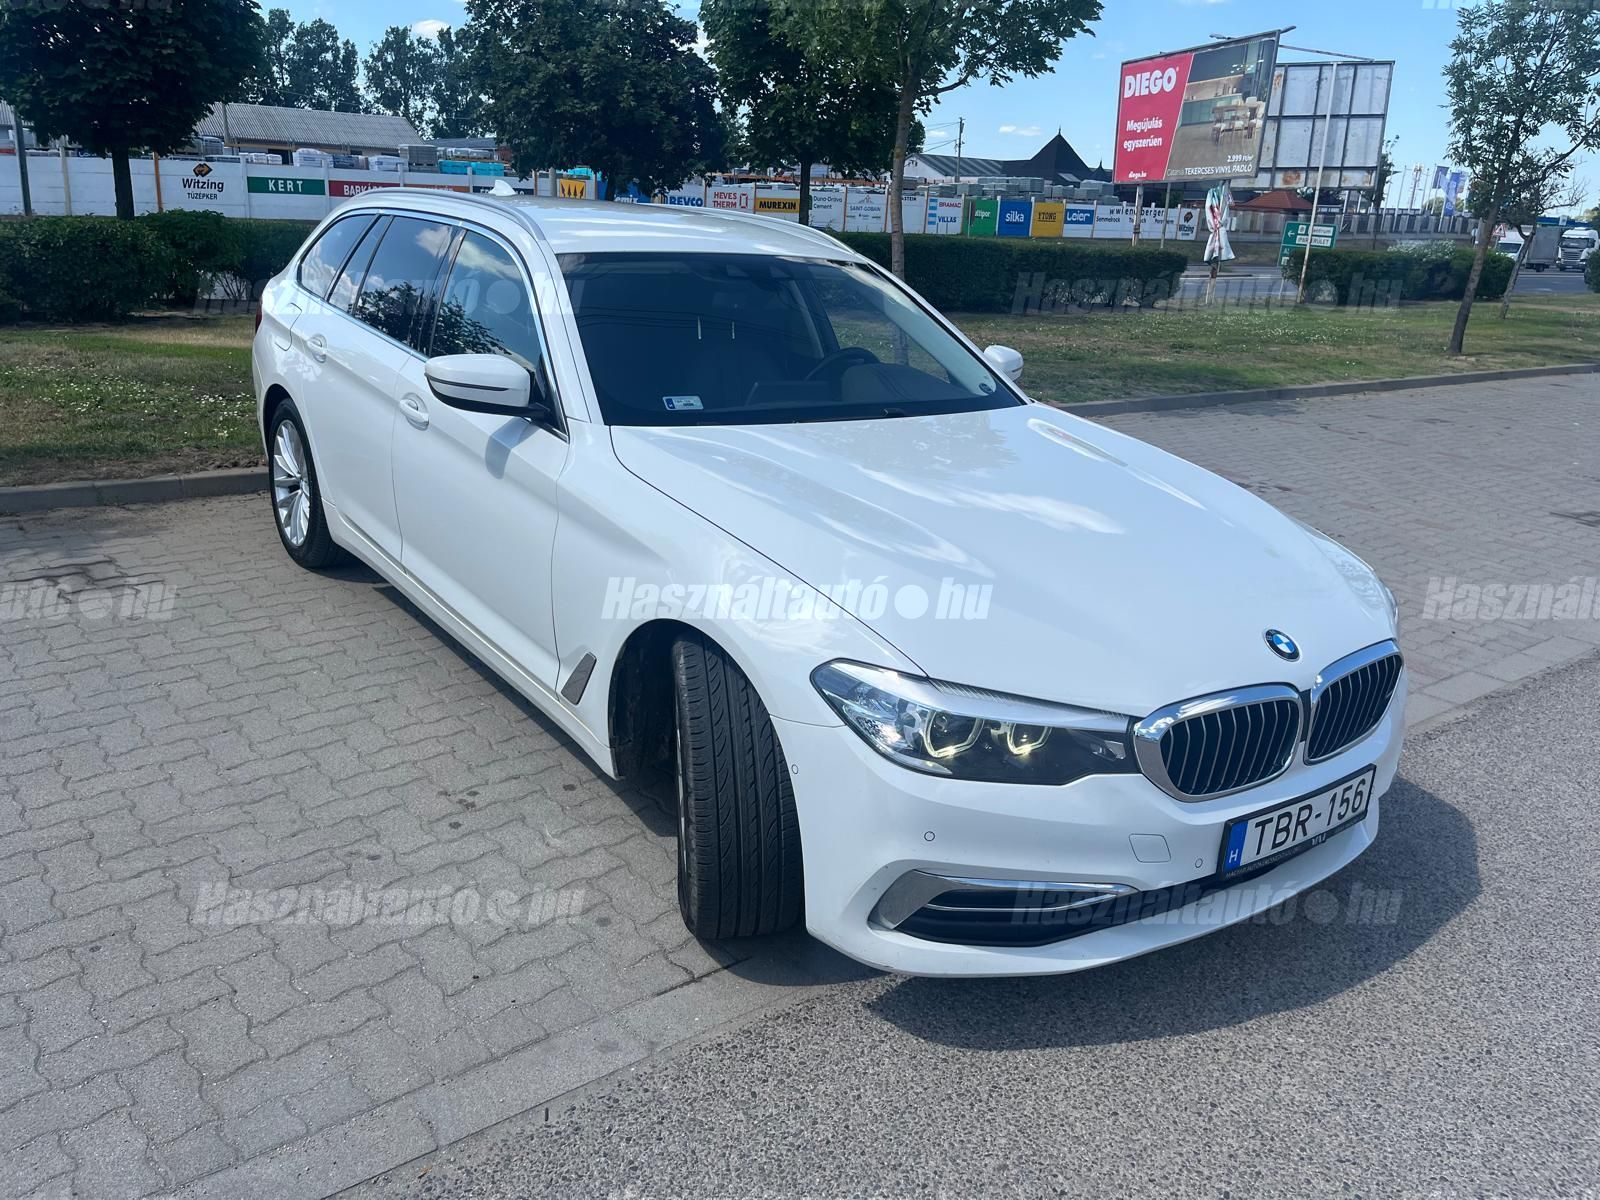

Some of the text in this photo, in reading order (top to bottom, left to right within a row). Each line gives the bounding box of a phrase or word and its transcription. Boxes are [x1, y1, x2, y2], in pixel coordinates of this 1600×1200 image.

[1123, 67, 1177, 99] DIEGO
[1126, 116, 1163, 132] Megújulás
[182, 178, 224, 192] Witzing
[269, 179, 304, 192] KERT
[713, 191, 737, 200] HEVES
[712, 200, 737, 209] THERM
[758, 200, 797, 210] MUREXIN
[1005, 210, 1025, 222] silka
[1066, 210, 1091, 222] Leier
[1254, 778, 1367, 856] TBR-156
[1228, 848, 1239, 864] H
